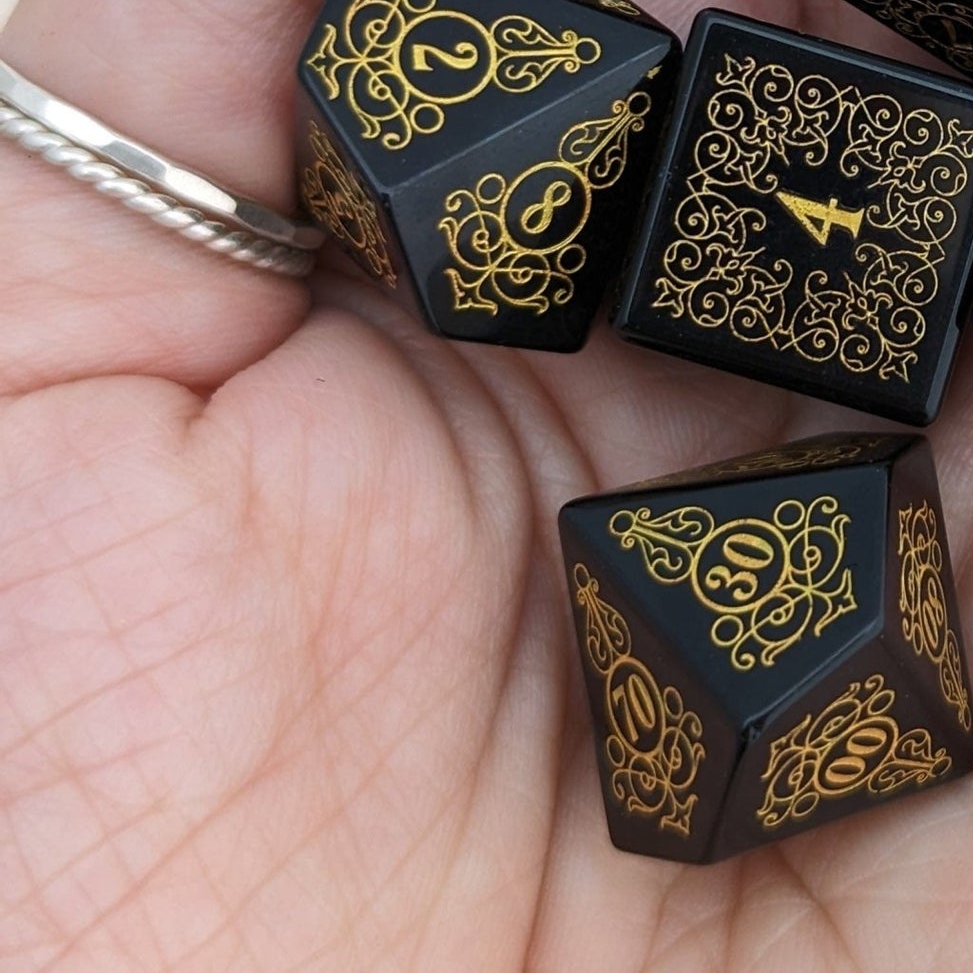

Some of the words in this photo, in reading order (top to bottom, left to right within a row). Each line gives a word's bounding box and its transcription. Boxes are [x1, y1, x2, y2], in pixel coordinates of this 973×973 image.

[411, 42, 479, 72] 2
[520, 179, 572, 235] 8
[775, 189, 866, 247] 4
[705, 533, 775, 601] 30
[612, 674, 657, 743] 70
[824, 726, 888, 784] 00
